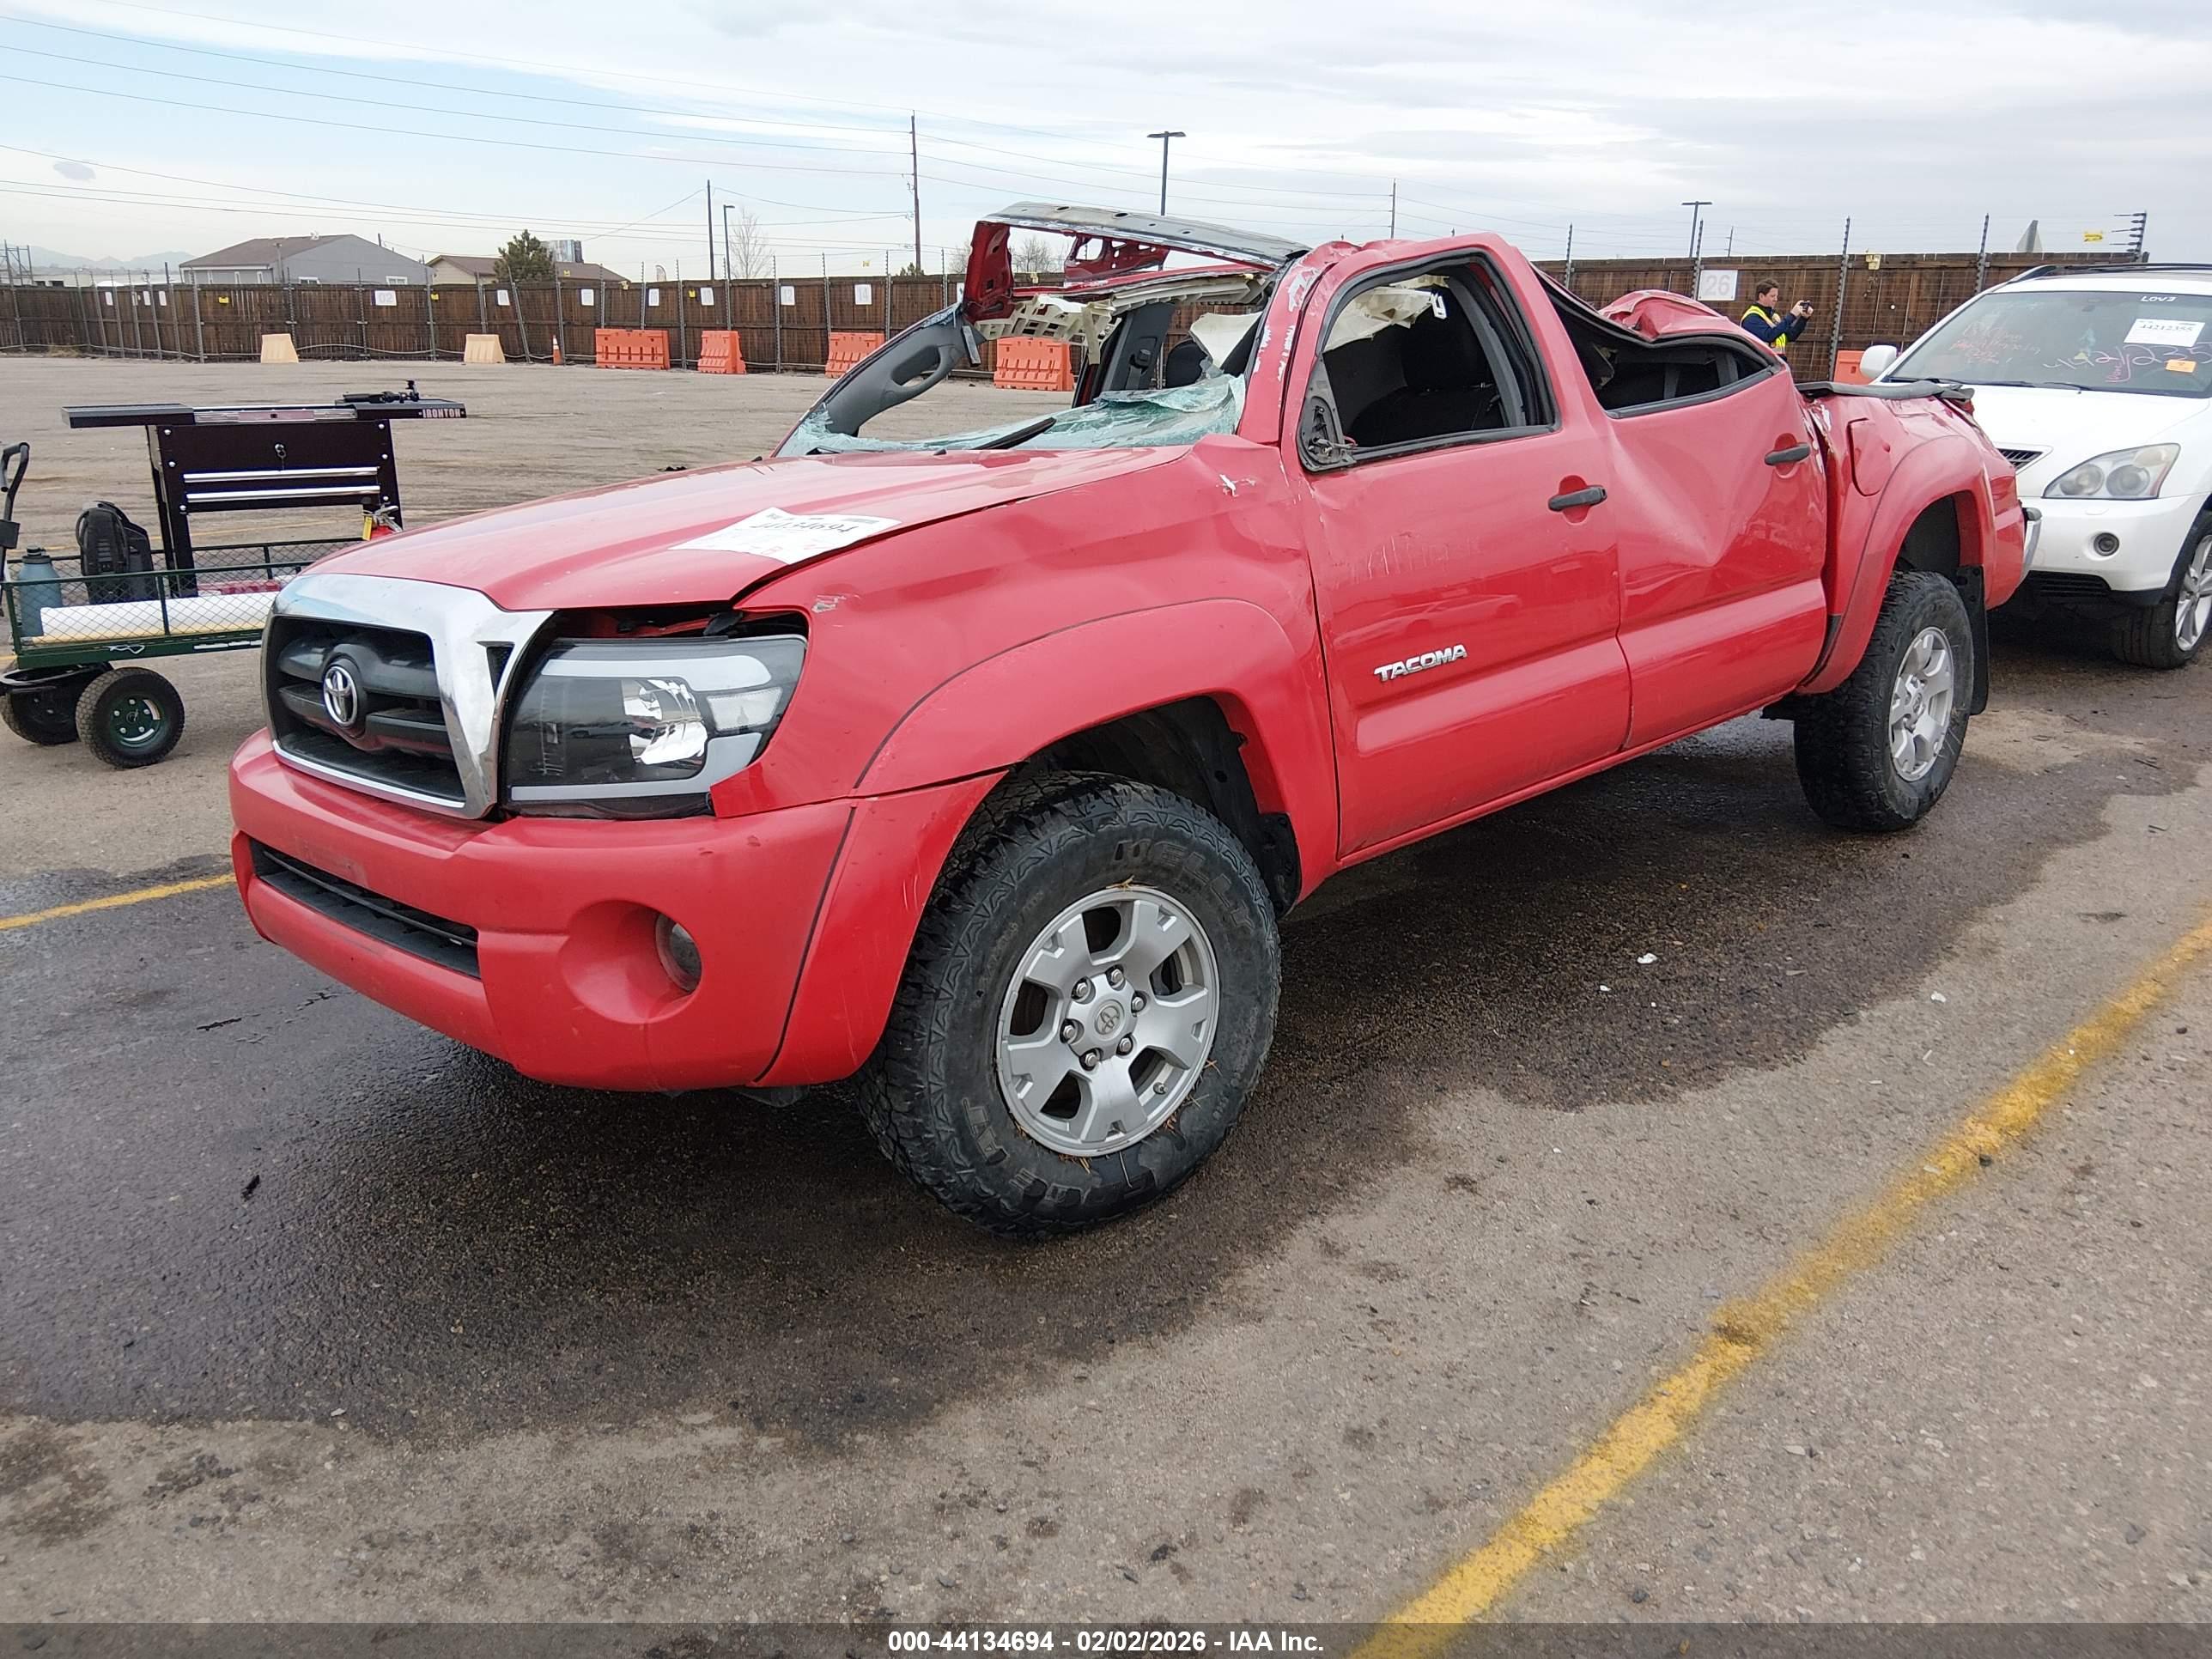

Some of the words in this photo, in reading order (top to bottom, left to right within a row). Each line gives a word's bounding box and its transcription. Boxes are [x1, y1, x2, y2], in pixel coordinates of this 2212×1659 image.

[1705, 274, 1730, 295] 26
[378, 293, 394, 305] 02
[422, 408, 461, 418] IRONTON
[1374, 644, 1468, 682] TACOMA
